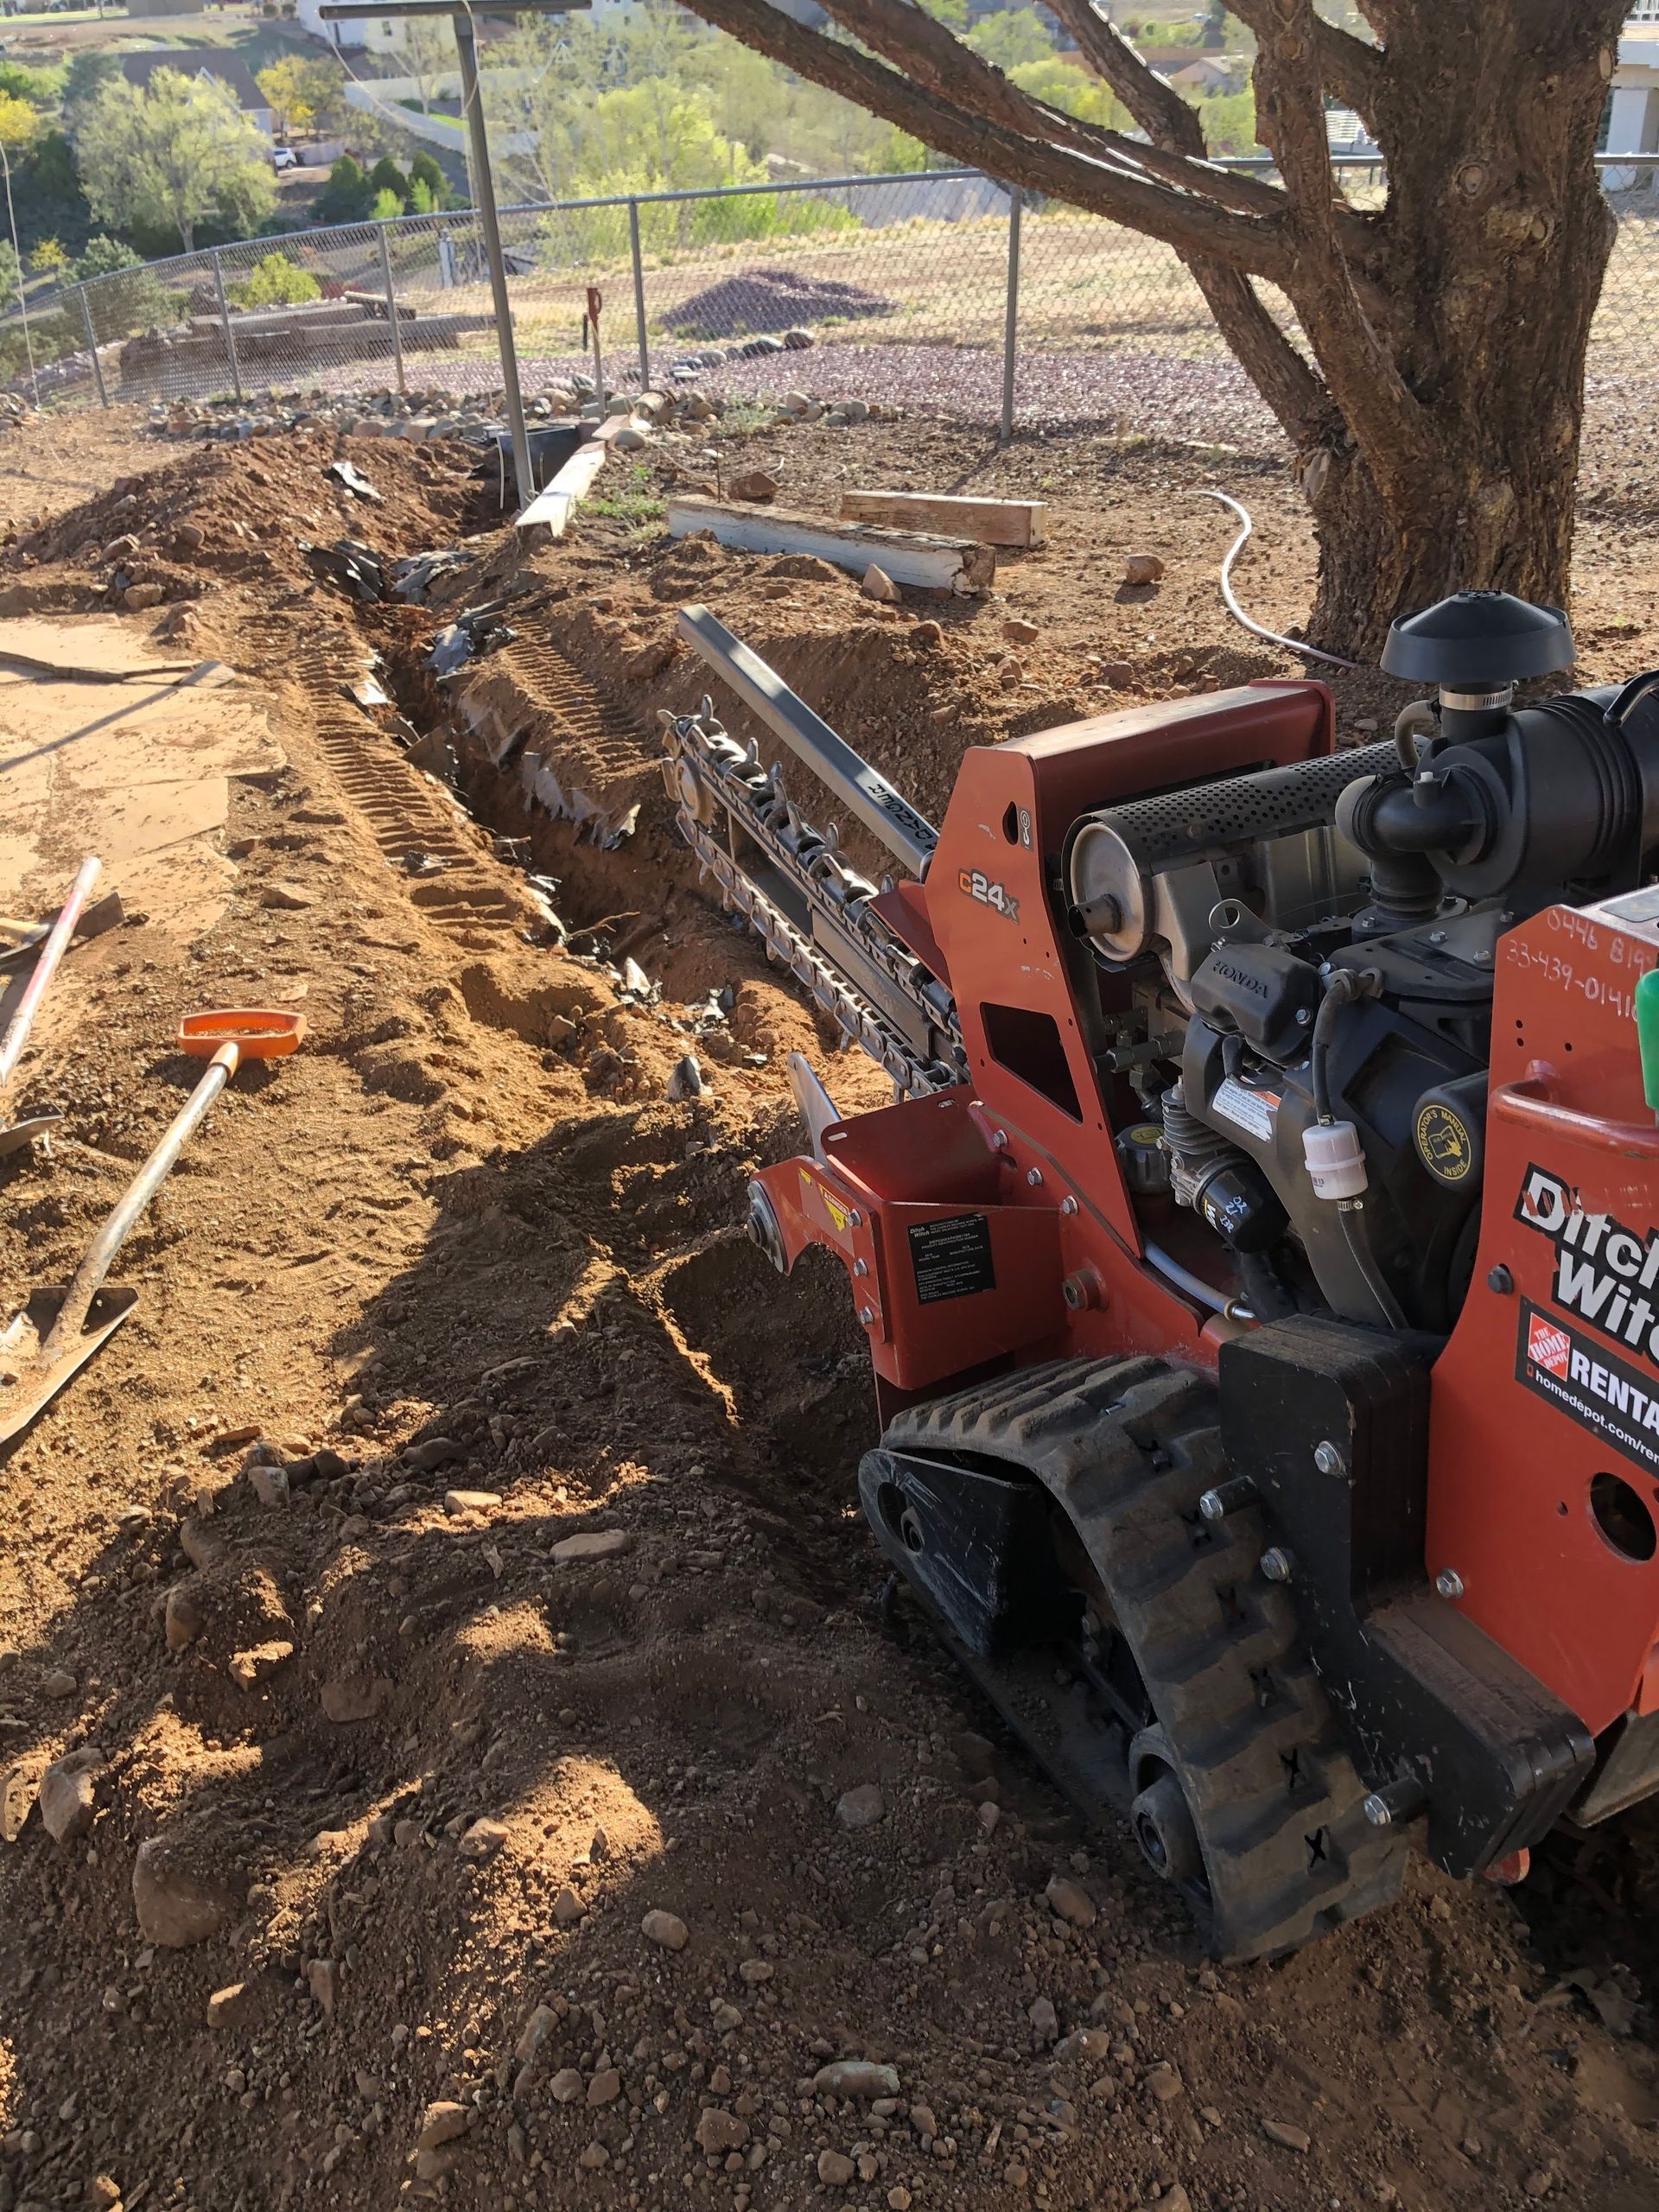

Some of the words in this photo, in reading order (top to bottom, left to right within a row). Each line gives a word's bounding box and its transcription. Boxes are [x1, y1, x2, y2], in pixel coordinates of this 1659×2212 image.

[868, 783, 933, 840] DANGER
[1547, 909, 1598, 950] 0446
[1212, 961, 1268, 999] HONDA
[1421, 1109, 1438, 1160] OPERATOR'S
[1441, 1110, 1466, 1144] MANUAL
[1444, 1159, 1467, 1176] INSIDE
[1557, 1249, 1659, 1363] Wit
[1529, 1332, 1570, 1361] HOME
[1534, 1326, 1551, 1341] THE
